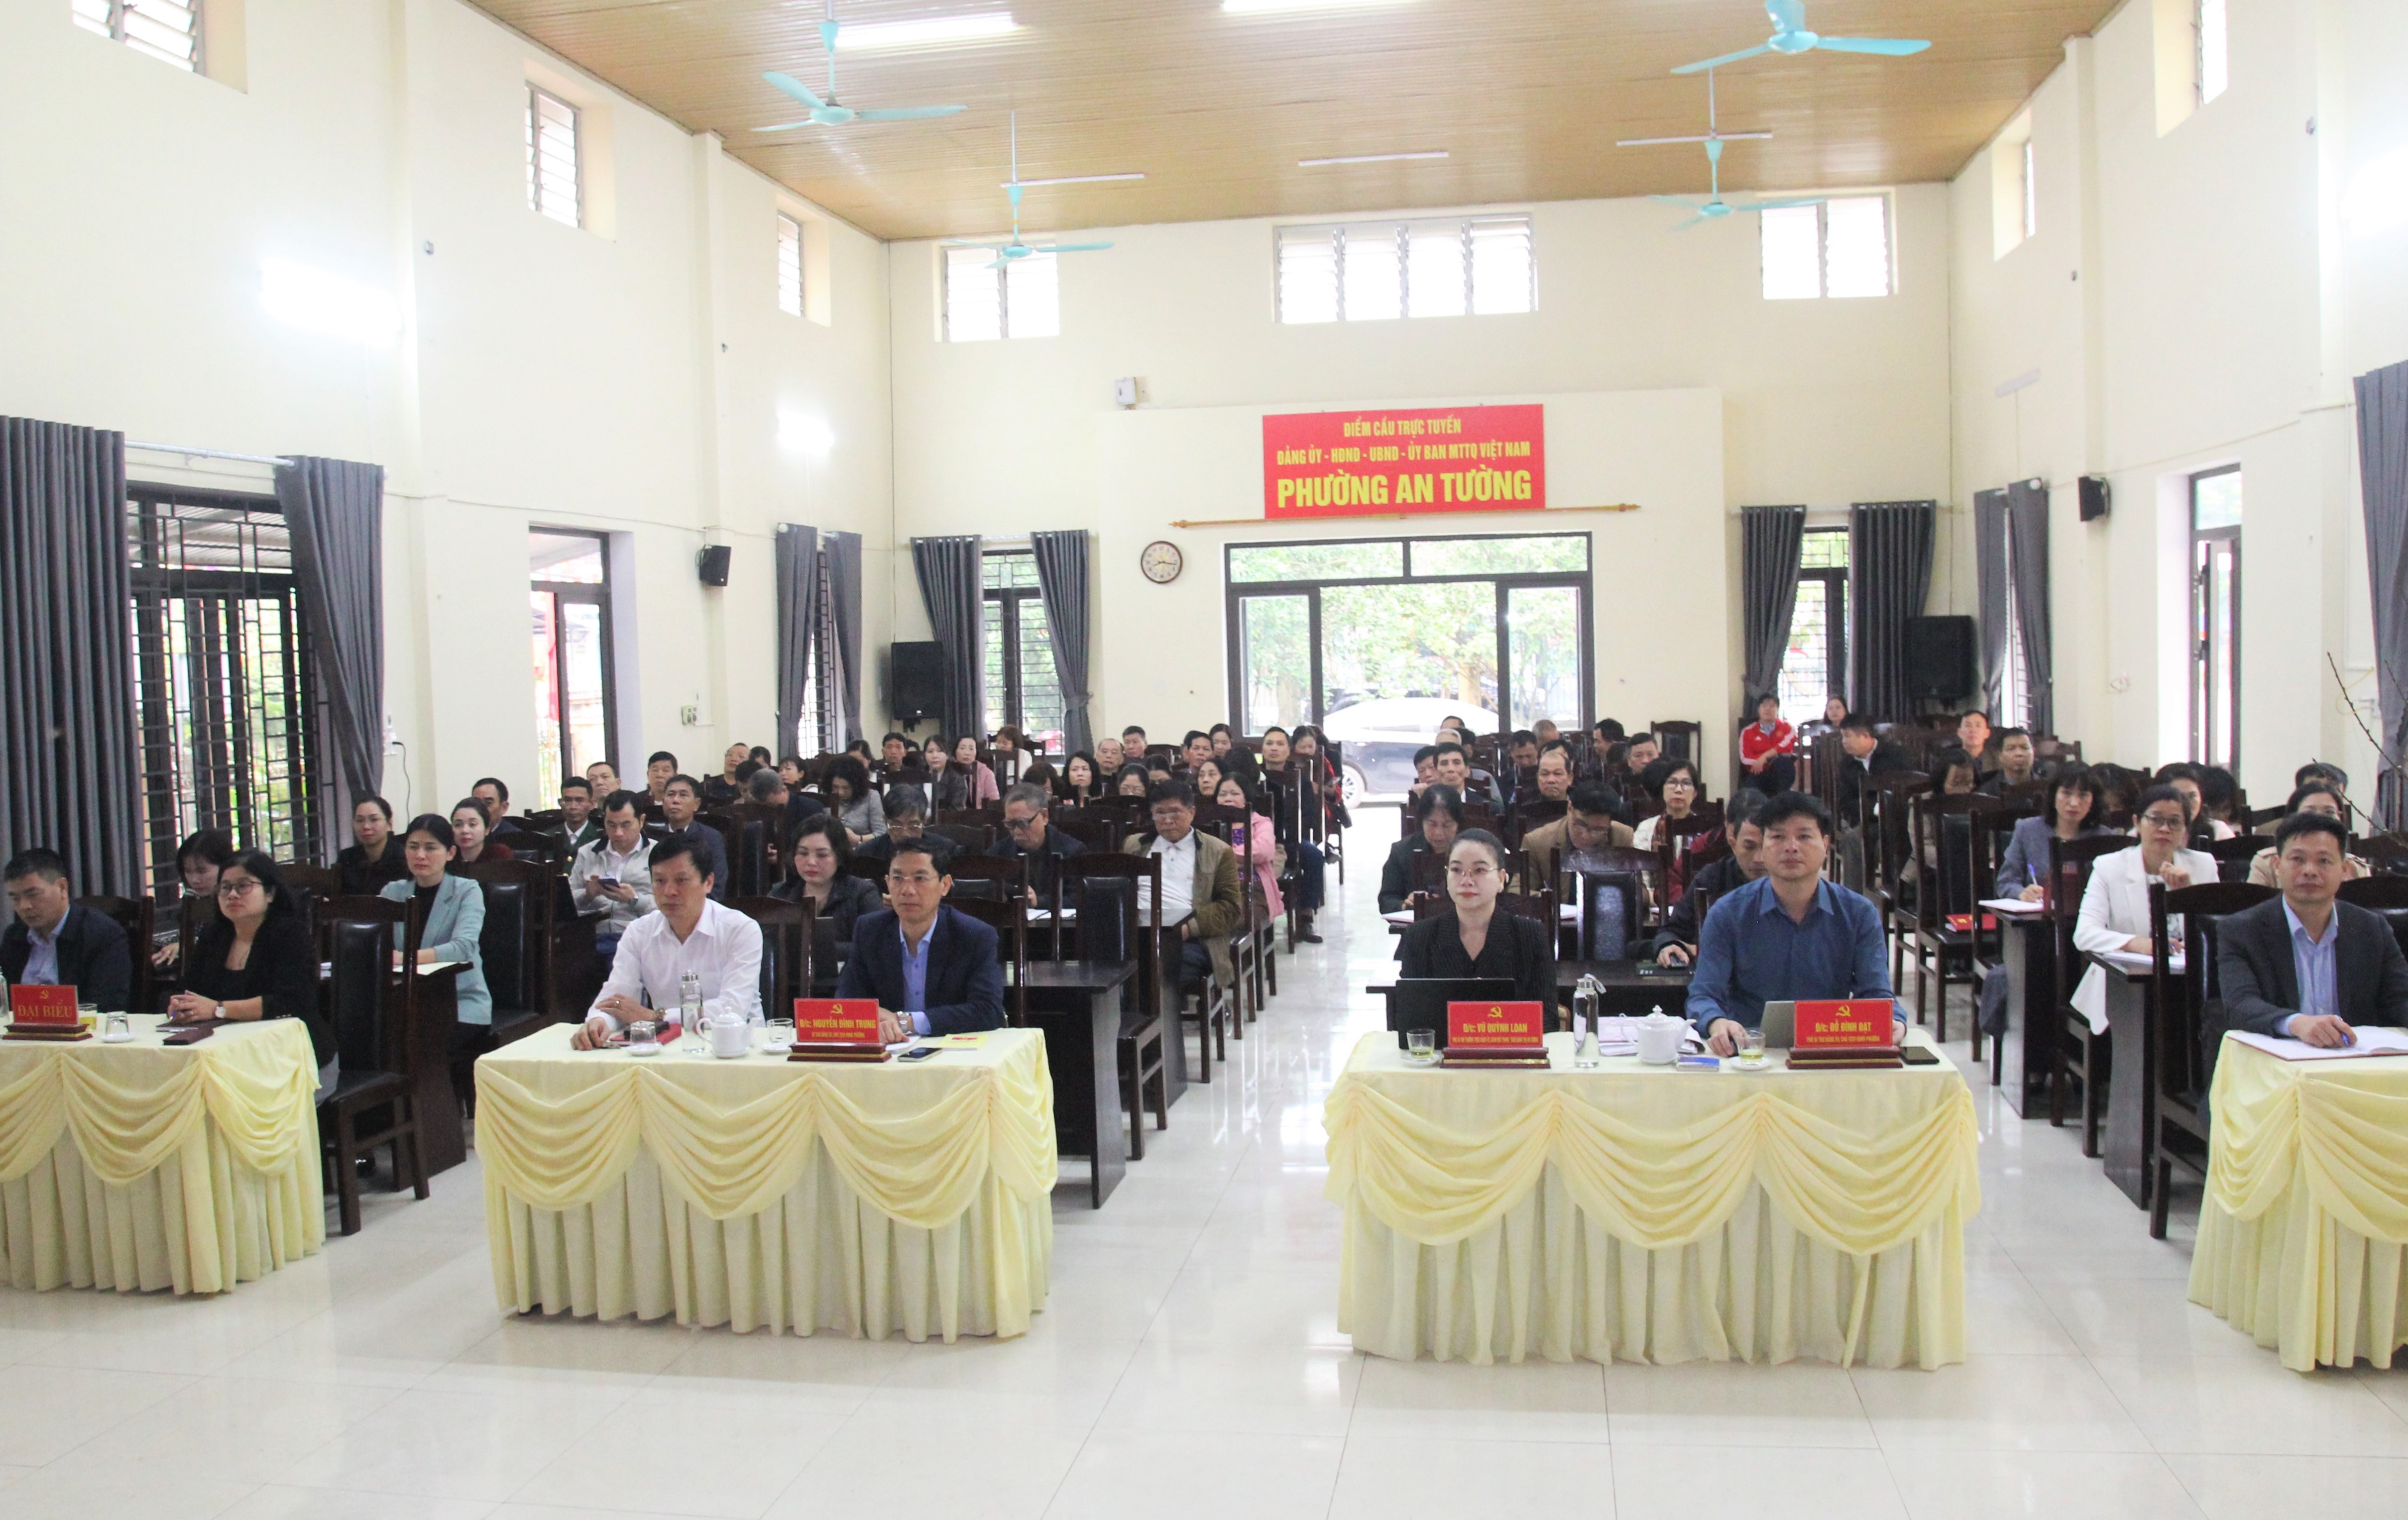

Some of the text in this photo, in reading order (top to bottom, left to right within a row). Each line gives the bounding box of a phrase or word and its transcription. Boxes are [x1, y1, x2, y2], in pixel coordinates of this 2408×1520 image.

[1344, 416, 1371, 437] ĐIỂM
[1397, 419, 1425, 438] TRỰC
[1427, 414, 1461, 434] TUYẾN
[1277, 445, 1306, 465] ĐẢNG
[1309, 444, 1322, 463] ỦY
[1331, 447, 1360, 463] HĐND
[1370, 446, 1399, 462] UBND
[1408, 440, 1422, 460] ỦY
[1424, 444, 1446, 459] BAN
[1449, 443, 1478, 460] MTTQ
[1480, 438, 1502, 460] VIỆT
[1505, 441, 1530, 457] NAM
[1277, 464, 1531, 508] PHƯỜNG AN TƯỜNG
[17, 999, 72, 1019] ĐẠI BIỂU
[856, 1020, 876, 1028] TRUNG
[1510, 1023, 1527, 1033] LOAN
